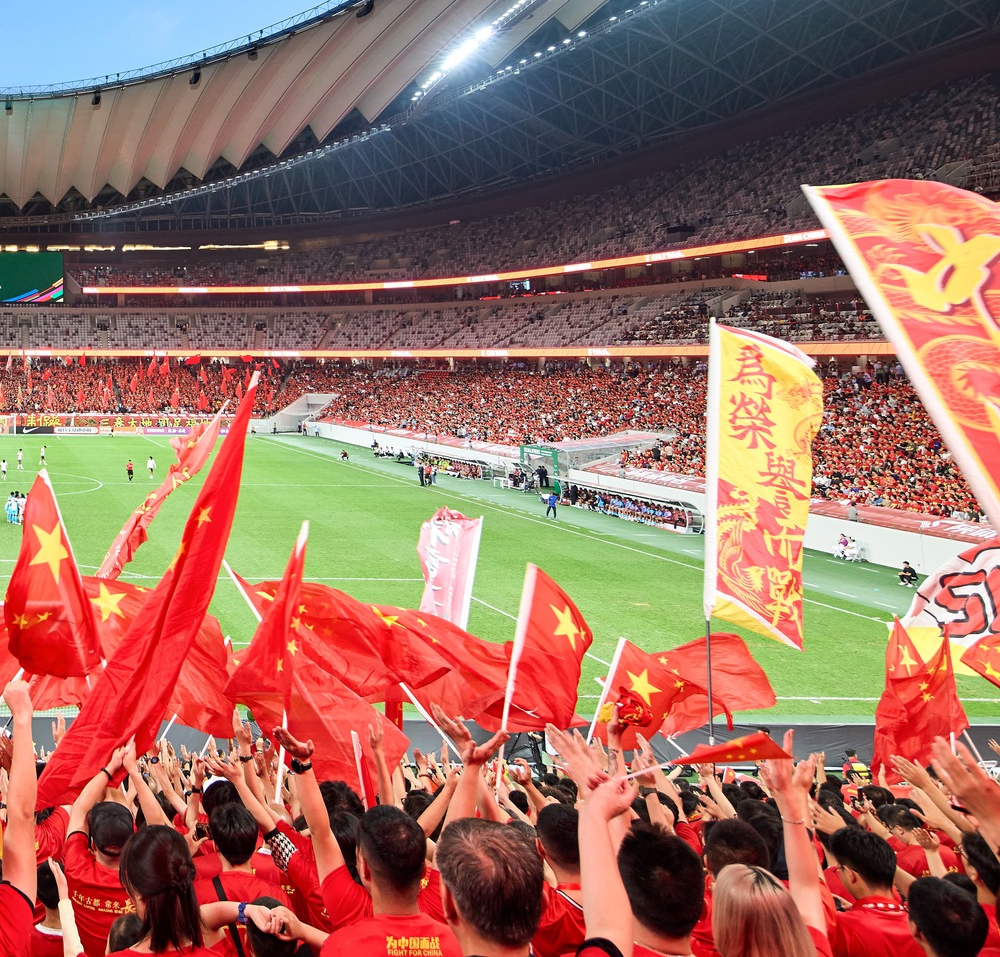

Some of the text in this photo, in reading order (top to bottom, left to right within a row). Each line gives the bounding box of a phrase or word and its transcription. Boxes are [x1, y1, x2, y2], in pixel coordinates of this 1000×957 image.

[386, 936, 440, 949] 为中国而战
